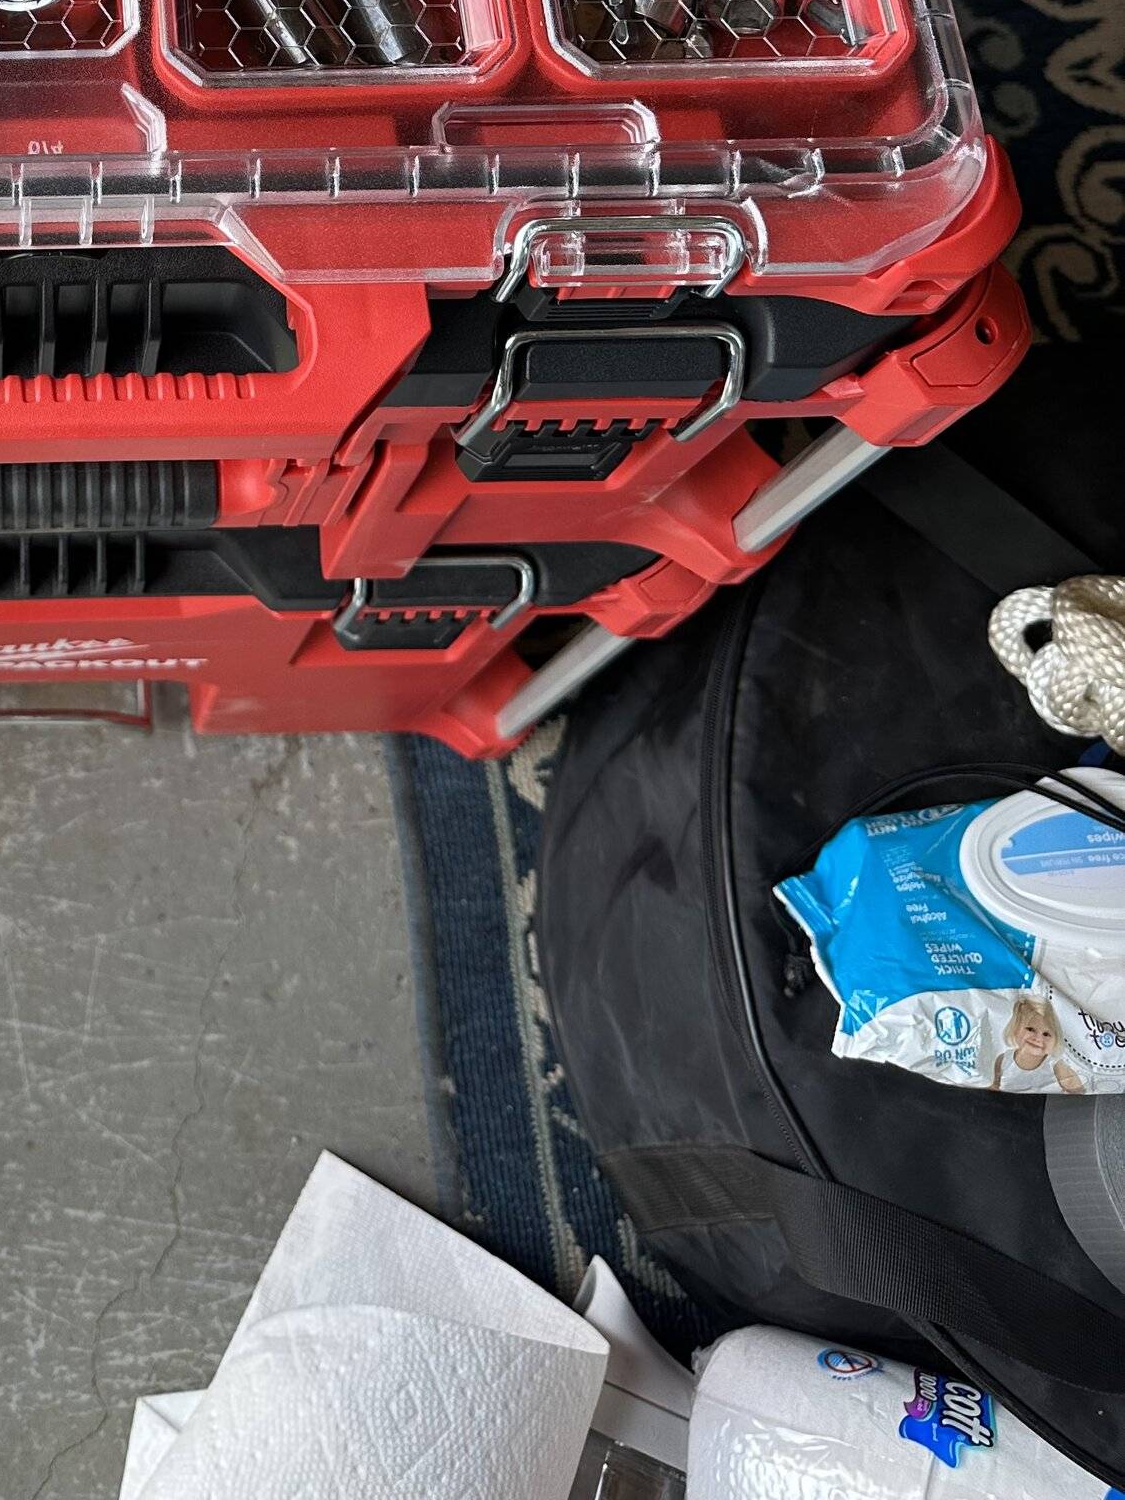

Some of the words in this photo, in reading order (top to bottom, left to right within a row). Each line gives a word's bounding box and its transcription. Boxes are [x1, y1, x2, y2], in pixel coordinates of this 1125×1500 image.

[906, 903, 929, 914] Free
[910, 911, 948, 924] Alcohol
[925, 942, 963, 954] WIPES
[931, 953, 983, 965] QUILTED
[934, 964, 975, 976] THICK
[919, 1372, 938, 1401] 1000
[941, 1381, 993, 1447] cott
